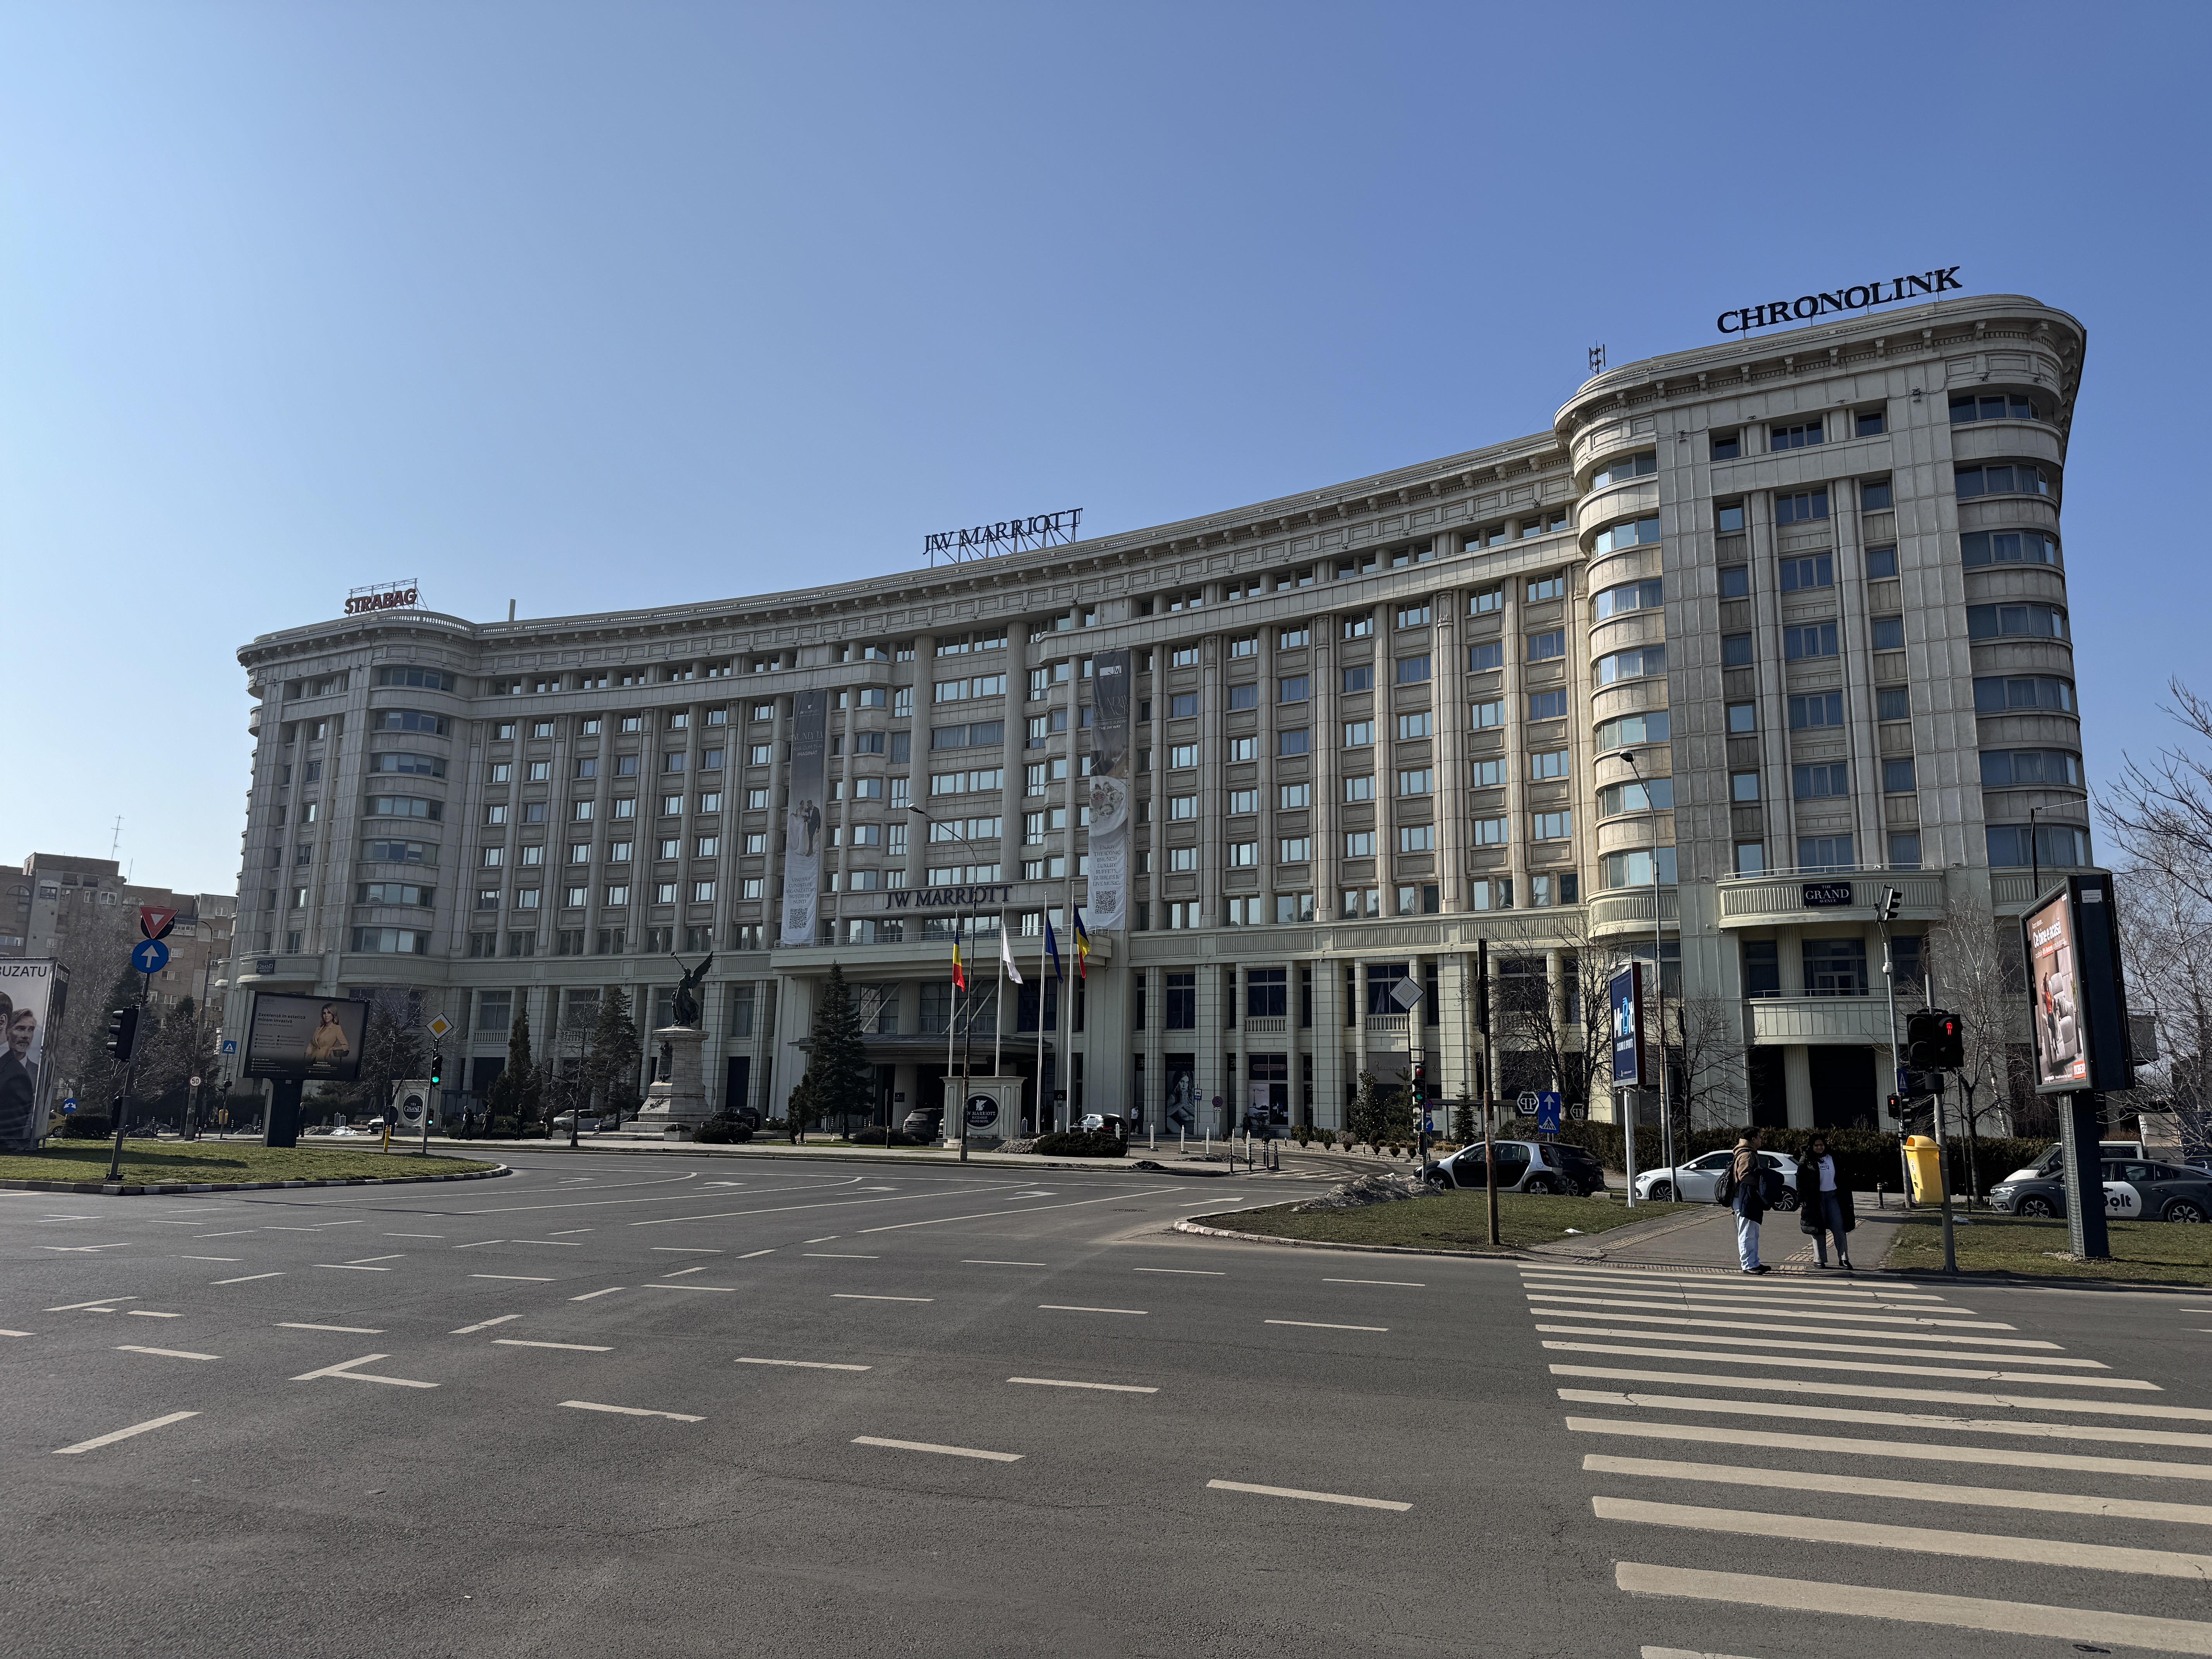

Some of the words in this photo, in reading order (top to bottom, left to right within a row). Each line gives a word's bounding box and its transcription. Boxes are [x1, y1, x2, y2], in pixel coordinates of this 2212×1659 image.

[1717, 266, 1963, 333] CHRONOLINK
[922, 531, 954, 555] JW
[960, 508, 1083, 546] MARRIOTT
[344, 588, 417, 614] STRABAG
[885, 892, 911, 909] JW
[915, 885, 1012, 906] MARRIOTT
[1805, 889, 1849, 899] GRAND
[2033, 932, 2039, 948] Ce
[2038, 928, 2047, 945] bine
[2049, 917, 2061, 939] acasă
[0, 966, 47, 977] UZATU
